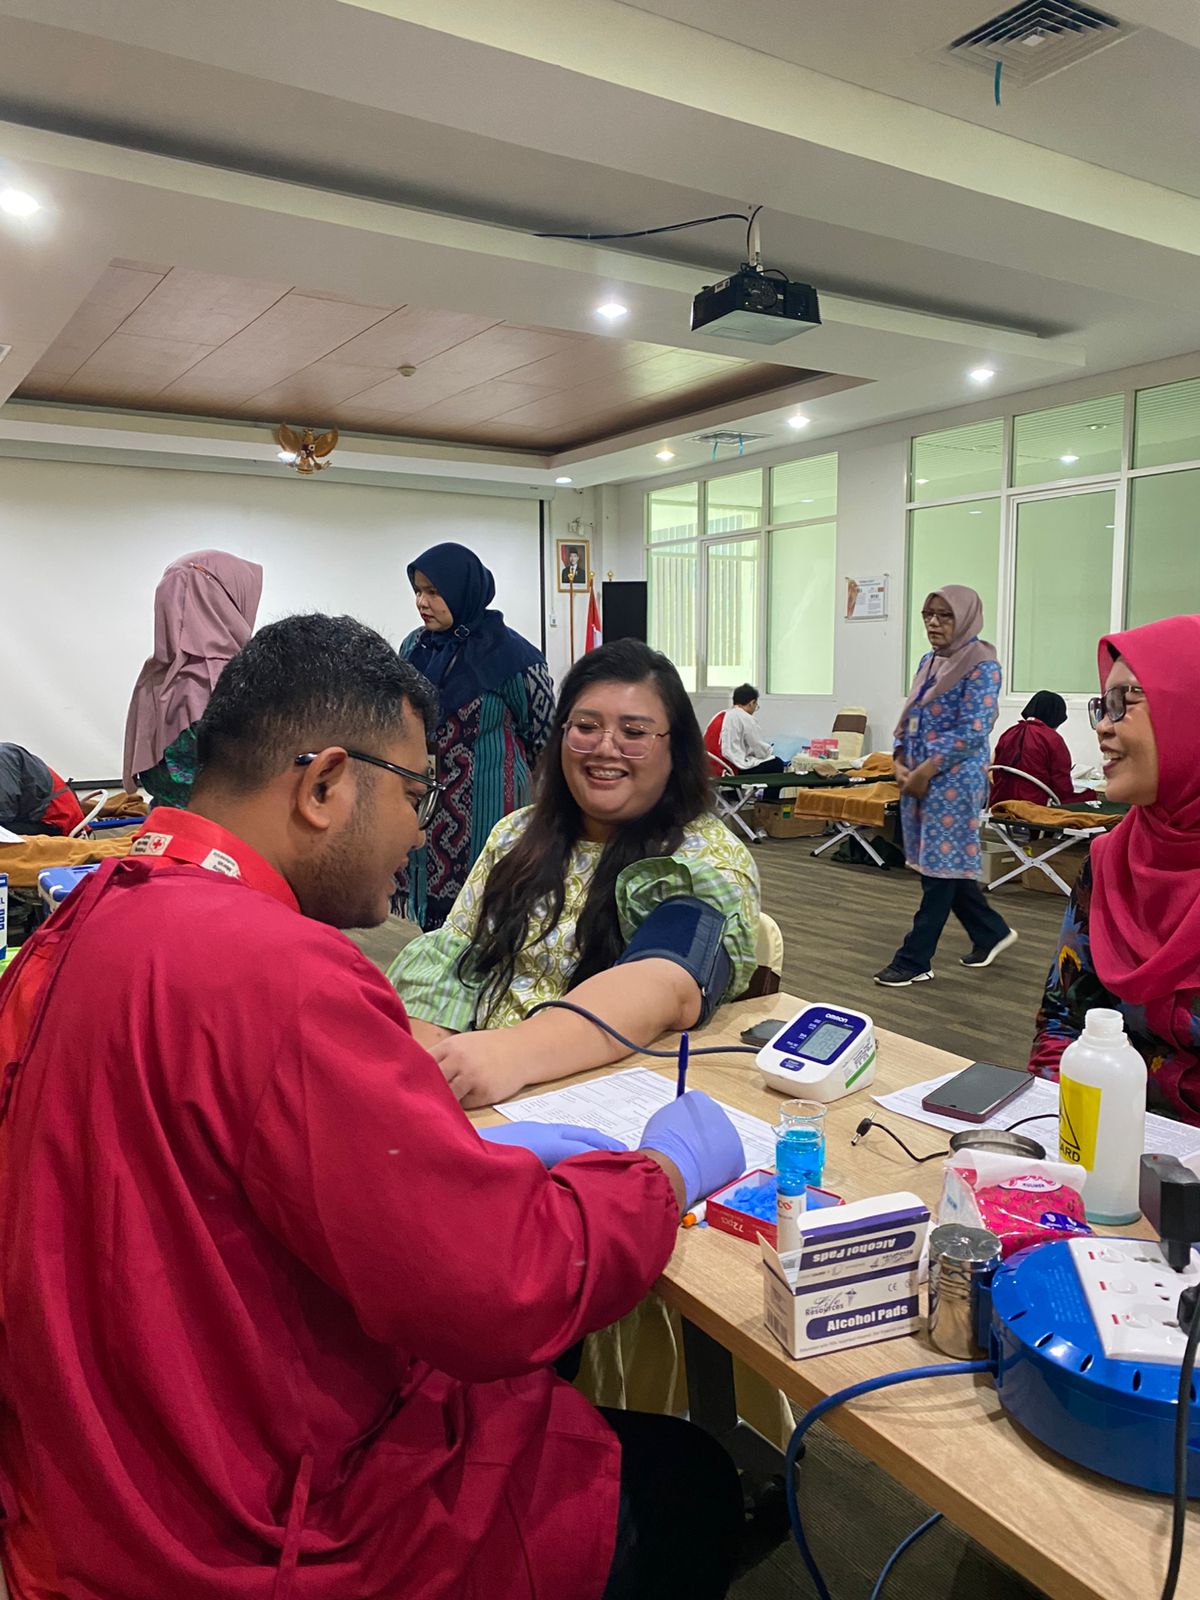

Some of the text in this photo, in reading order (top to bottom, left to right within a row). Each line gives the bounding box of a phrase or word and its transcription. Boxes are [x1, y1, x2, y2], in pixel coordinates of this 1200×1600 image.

[812, 1248, 846, 1263] Pads
[847, 1238, 897, 1257] Alcohol
[826, 1304, 909, 1332] Alcohol Pads
